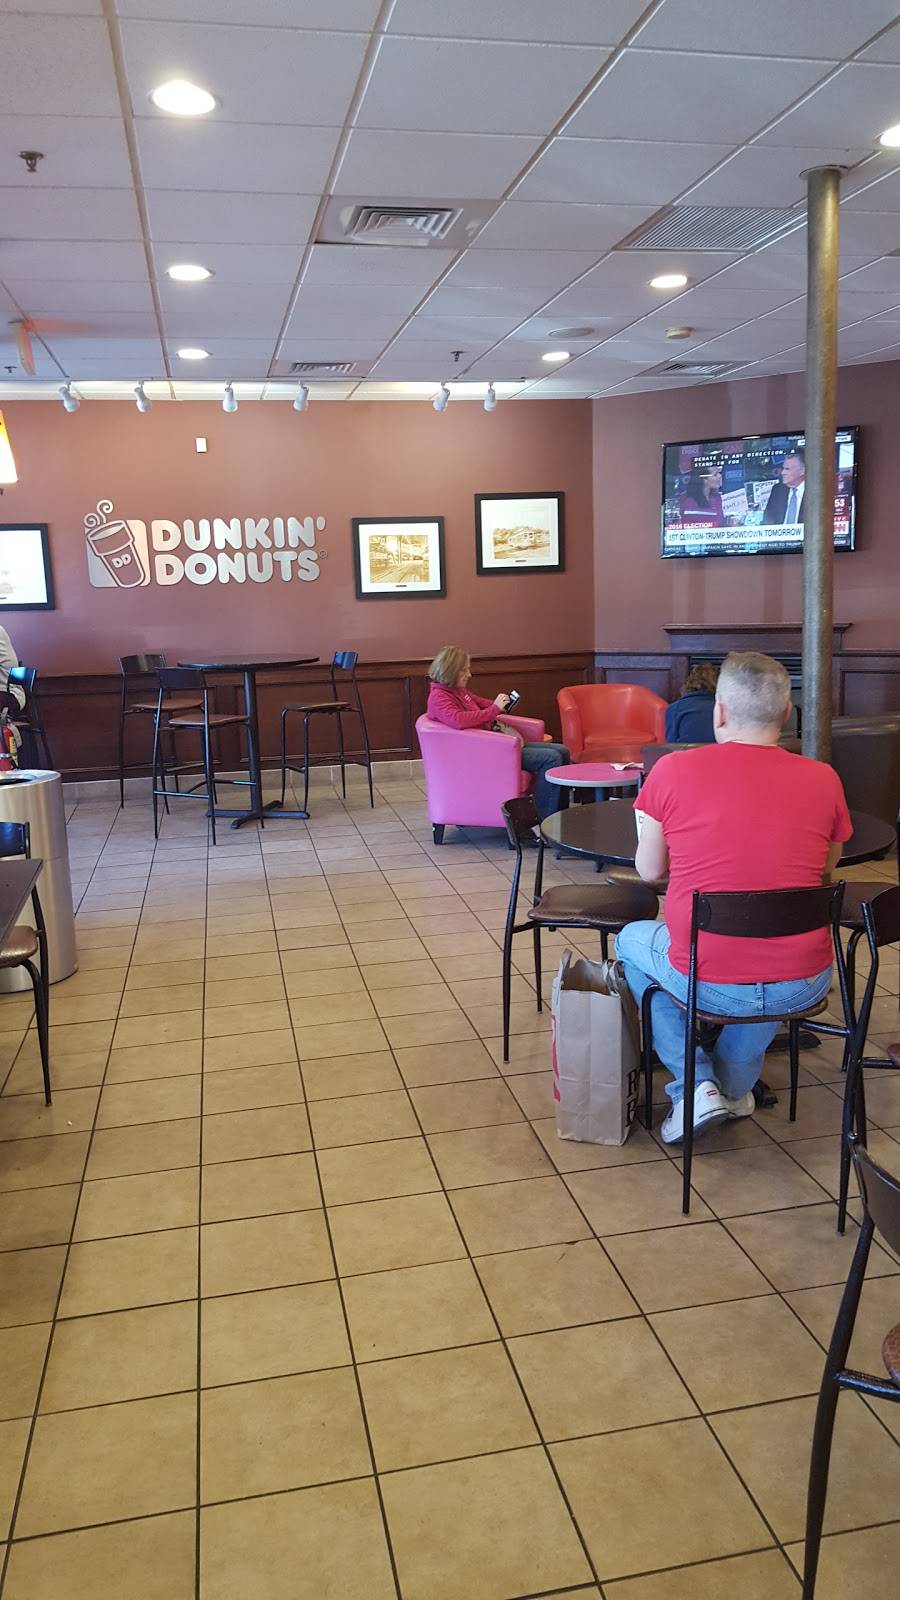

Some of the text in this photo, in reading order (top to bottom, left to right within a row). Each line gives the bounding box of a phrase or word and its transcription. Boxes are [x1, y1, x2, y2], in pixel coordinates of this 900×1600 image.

[151, 516, 326, 552] DUNKIN'
[669, 528, 802, 542] 1ST CLINTON-TRUMP SHOWDOWN TOMORROW
[154, 549, 321, 586] DONUTS
